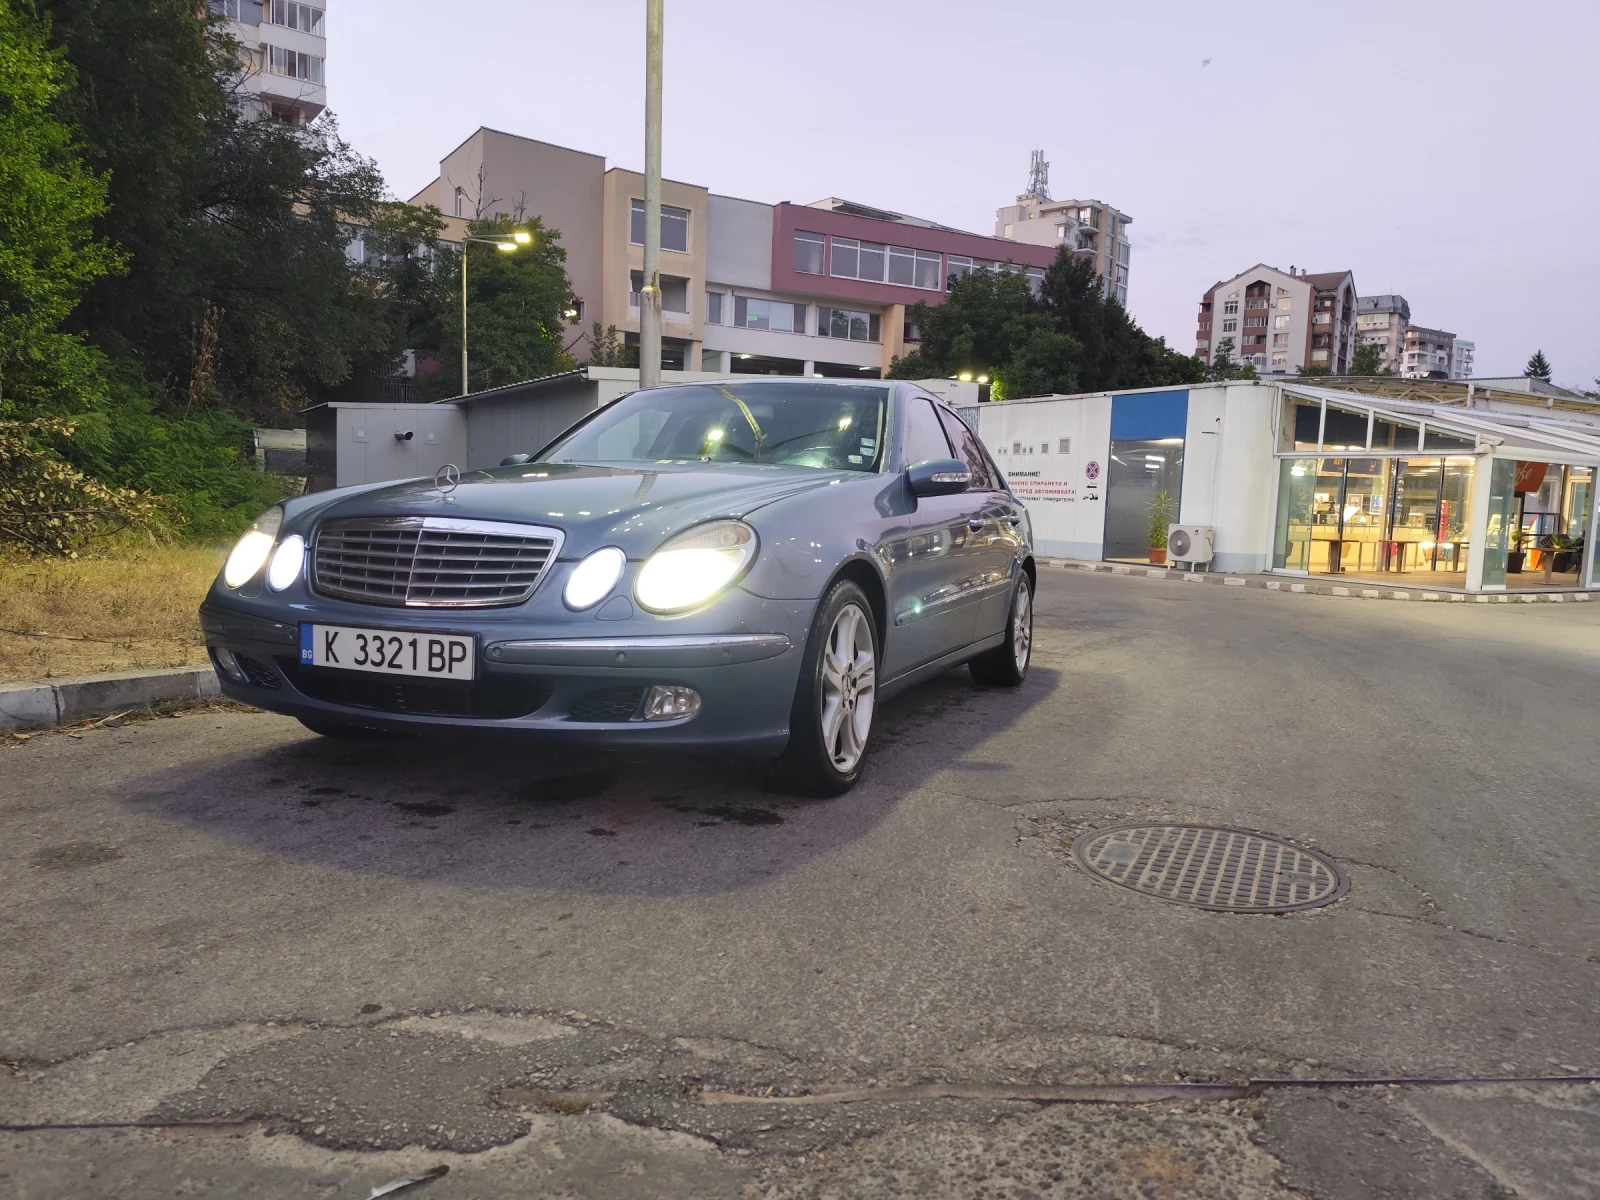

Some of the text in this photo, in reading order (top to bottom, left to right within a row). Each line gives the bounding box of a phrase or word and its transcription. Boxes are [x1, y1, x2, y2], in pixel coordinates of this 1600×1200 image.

[301, 649, 313, 659] BG
[325, 630, 467, 674] K 3321 BP
